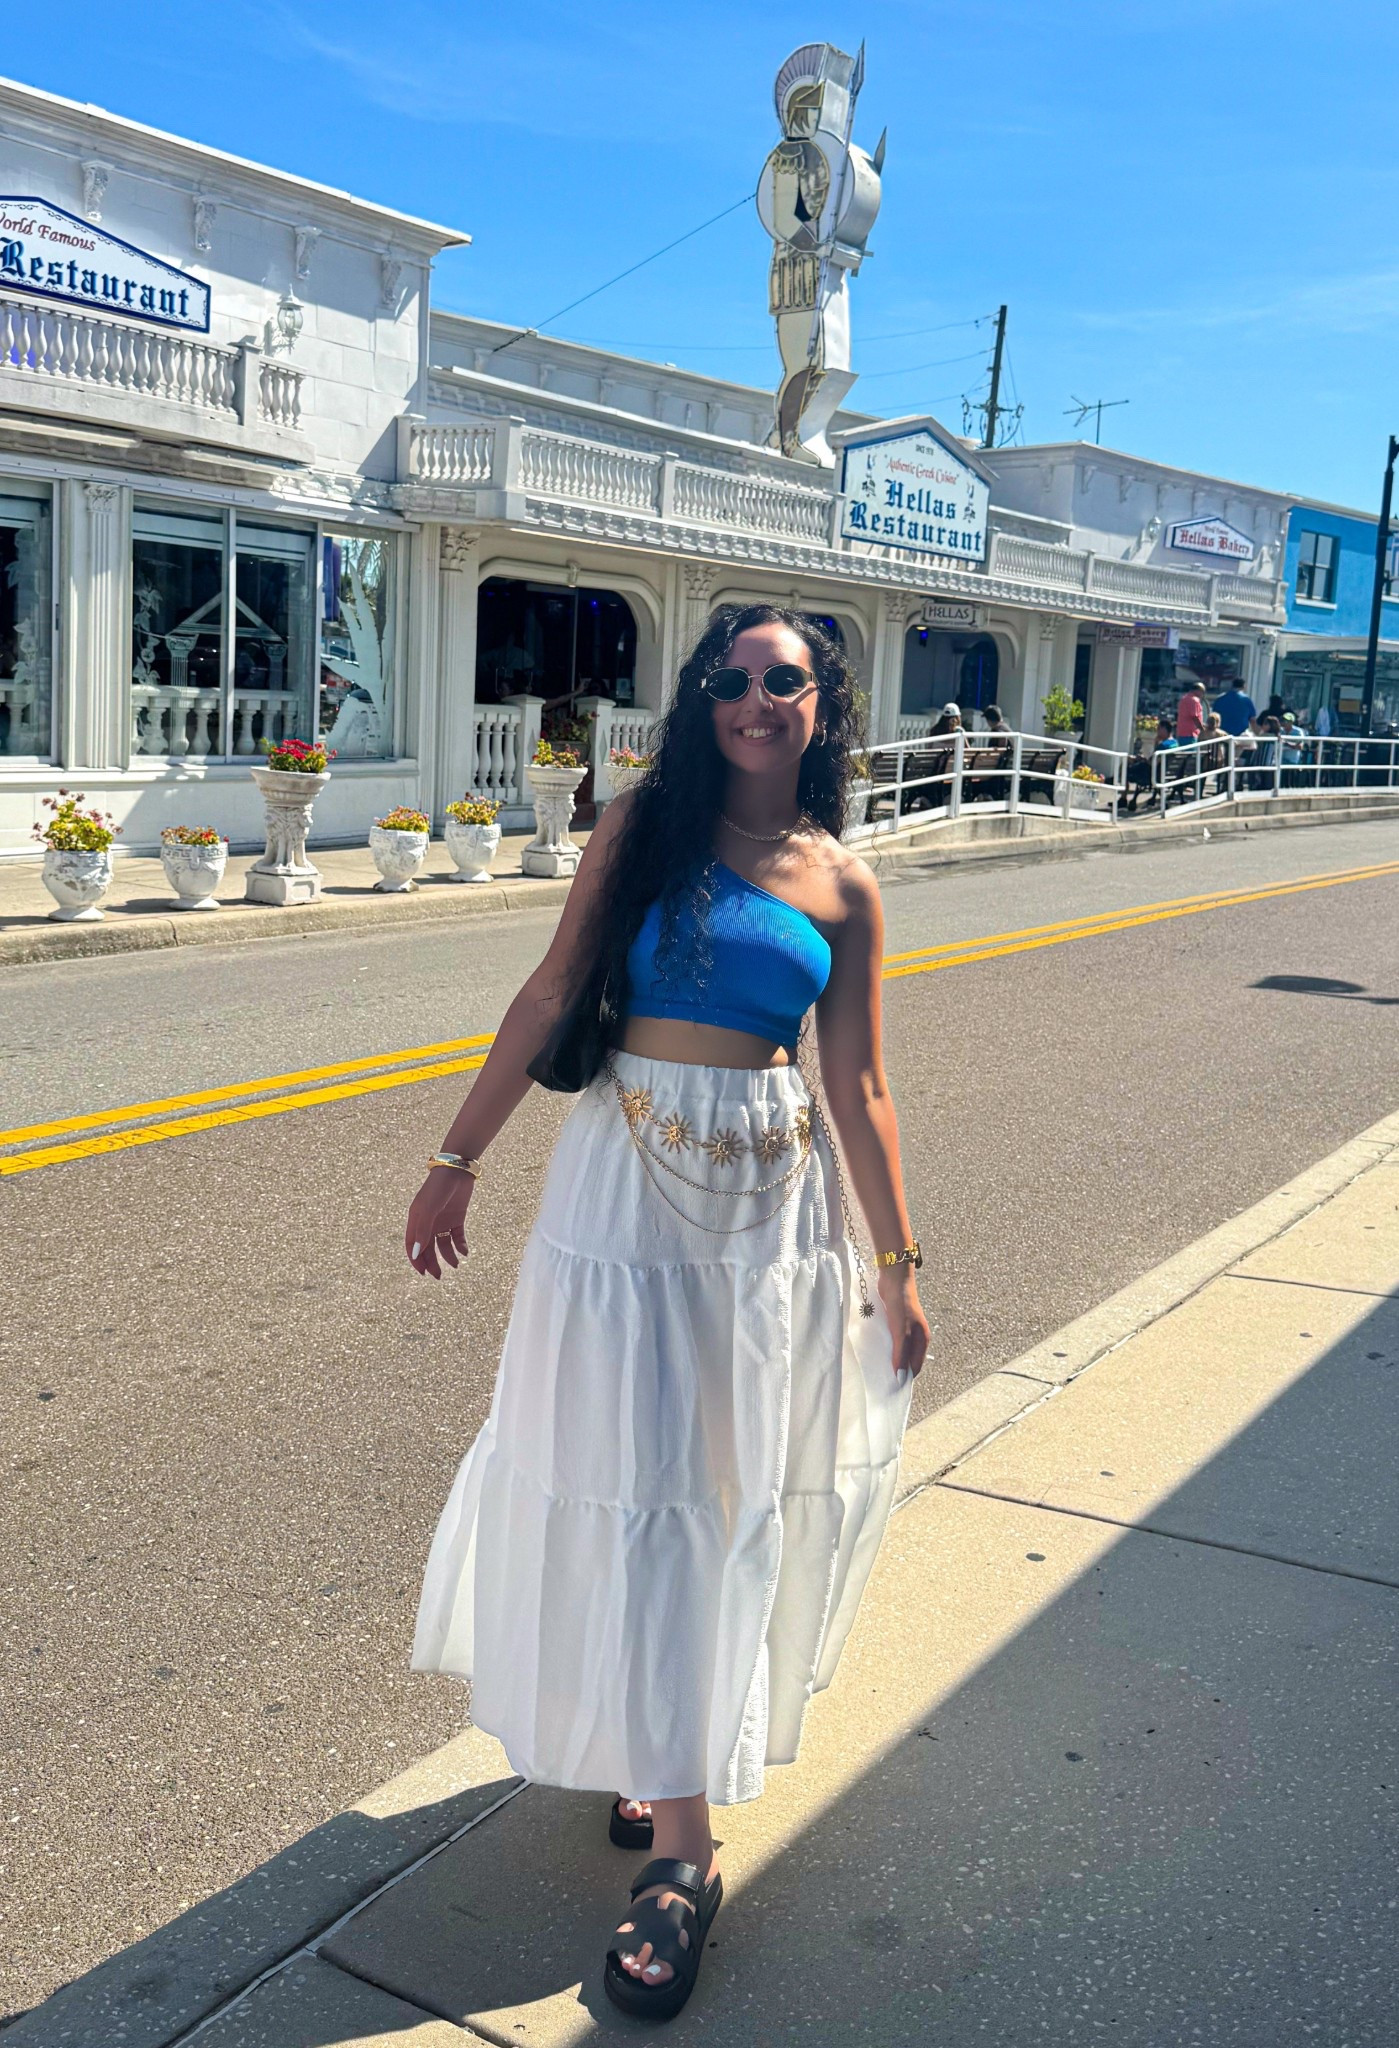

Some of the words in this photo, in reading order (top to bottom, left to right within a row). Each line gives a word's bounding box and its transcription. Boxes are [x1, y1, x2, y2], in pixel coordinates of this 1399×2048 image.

[38, 224, 96, 251] Famous
[0, 236, 190, 318] Restaurant
[884, 478, 956, 519] Hellas
[850, 500, 982, 552] Restaurant
[1180, 528, 1215, 548] Hellas
[1218, 535, 1250, 557] Bakery
[928, 606, 969, 619] HELLAS
